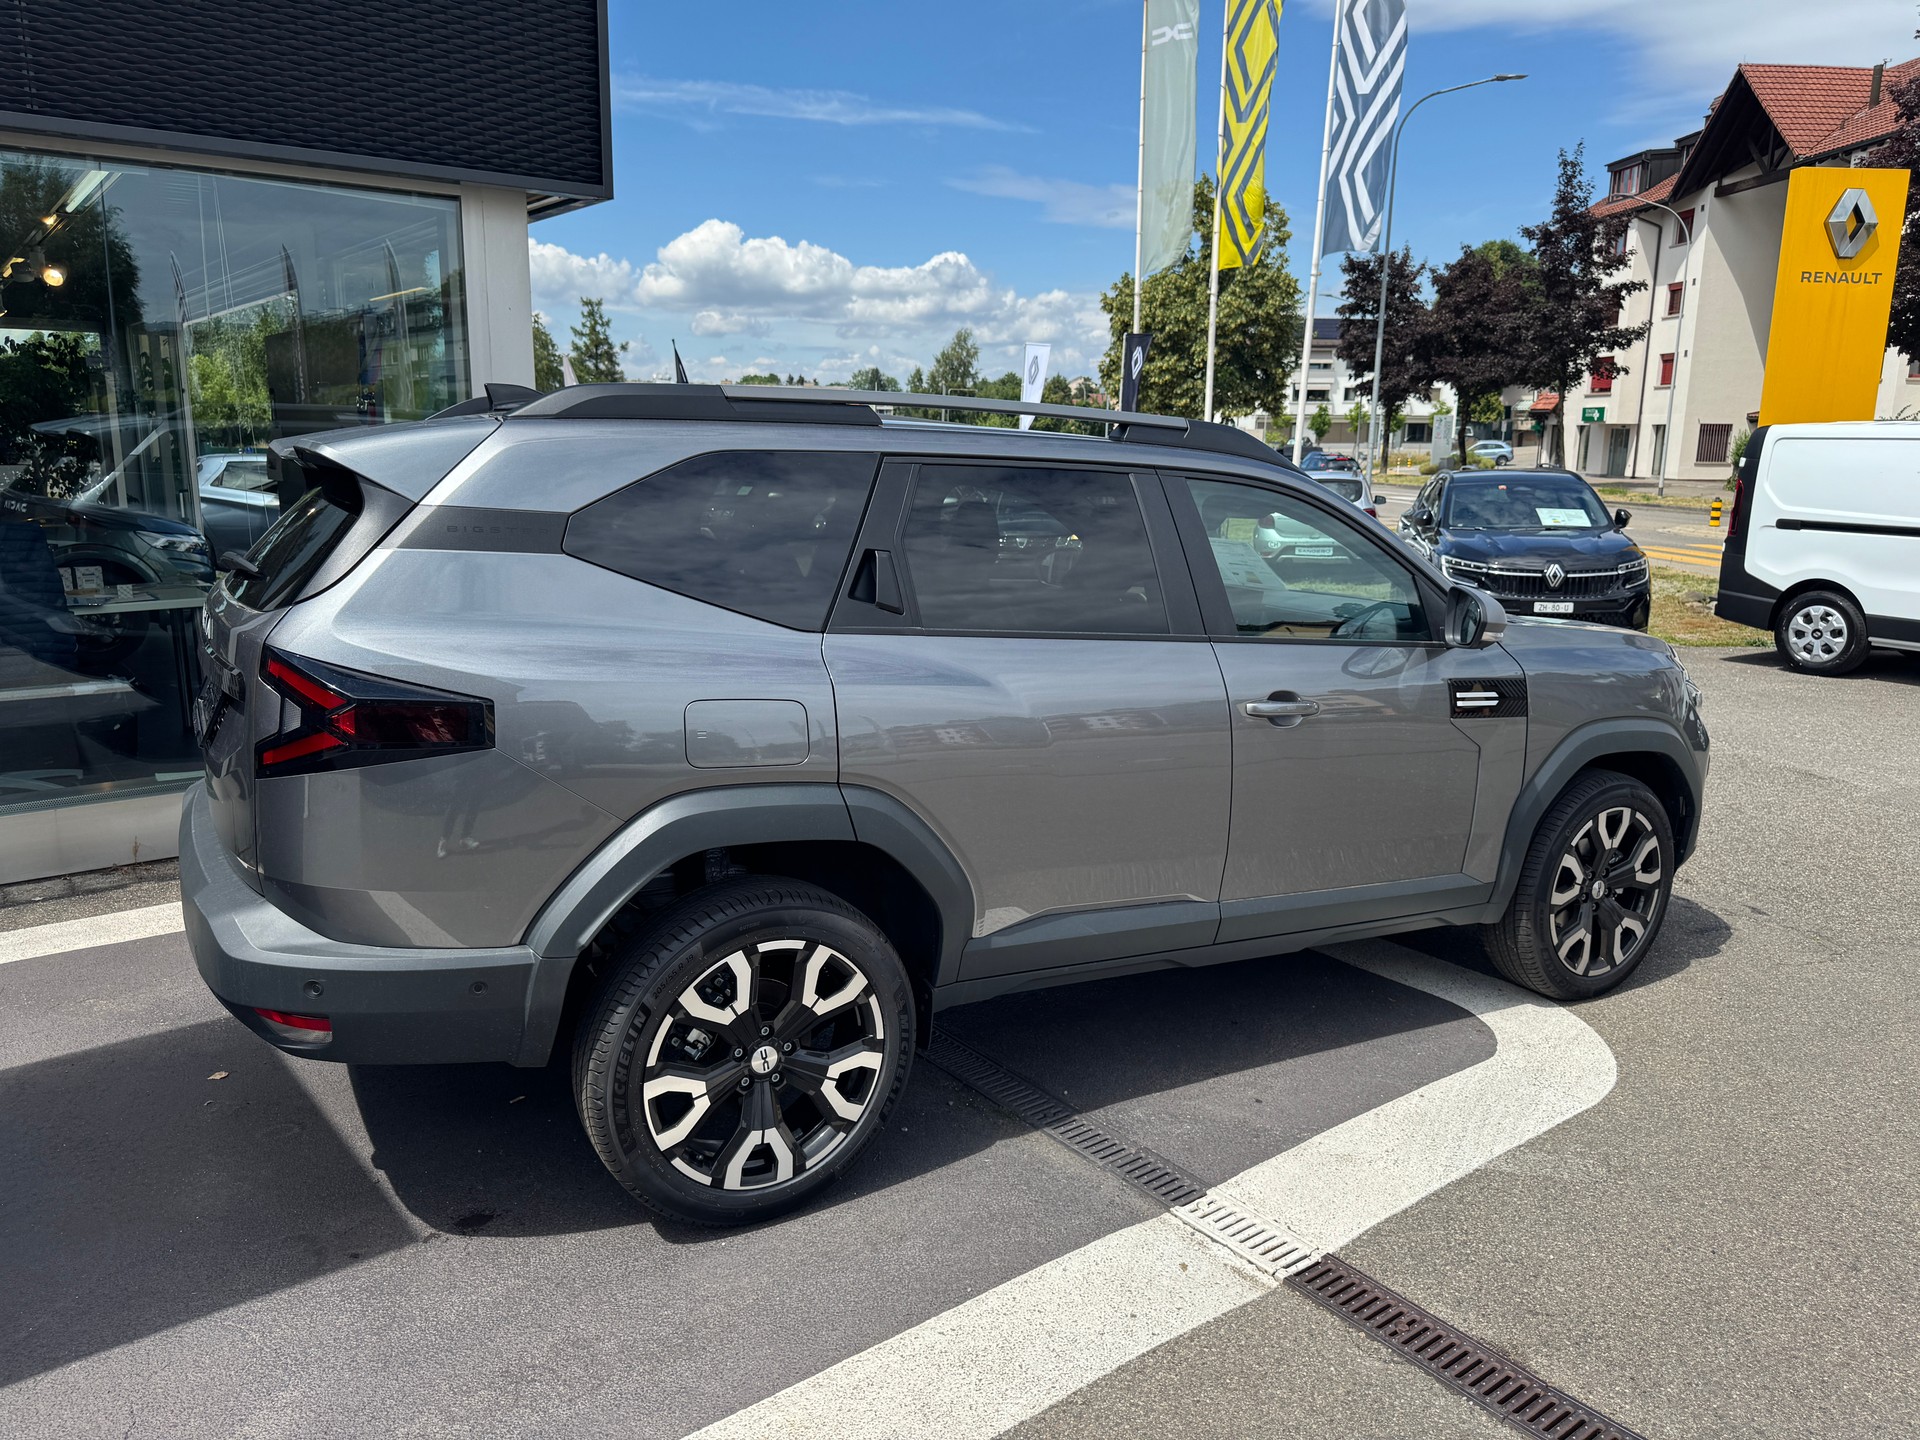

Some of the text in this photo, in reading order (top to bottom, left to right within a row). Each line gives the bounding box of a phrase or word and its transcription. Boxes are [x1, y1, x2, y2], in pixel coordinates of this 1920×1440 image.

[1800, 271, 1883, 284] RENAULT
[446, 525, 549, 535] BIGSTER
[614, 1008, 648, 1125] MICHELIN
[882, 1014, 909, 1115] MICHELIN
